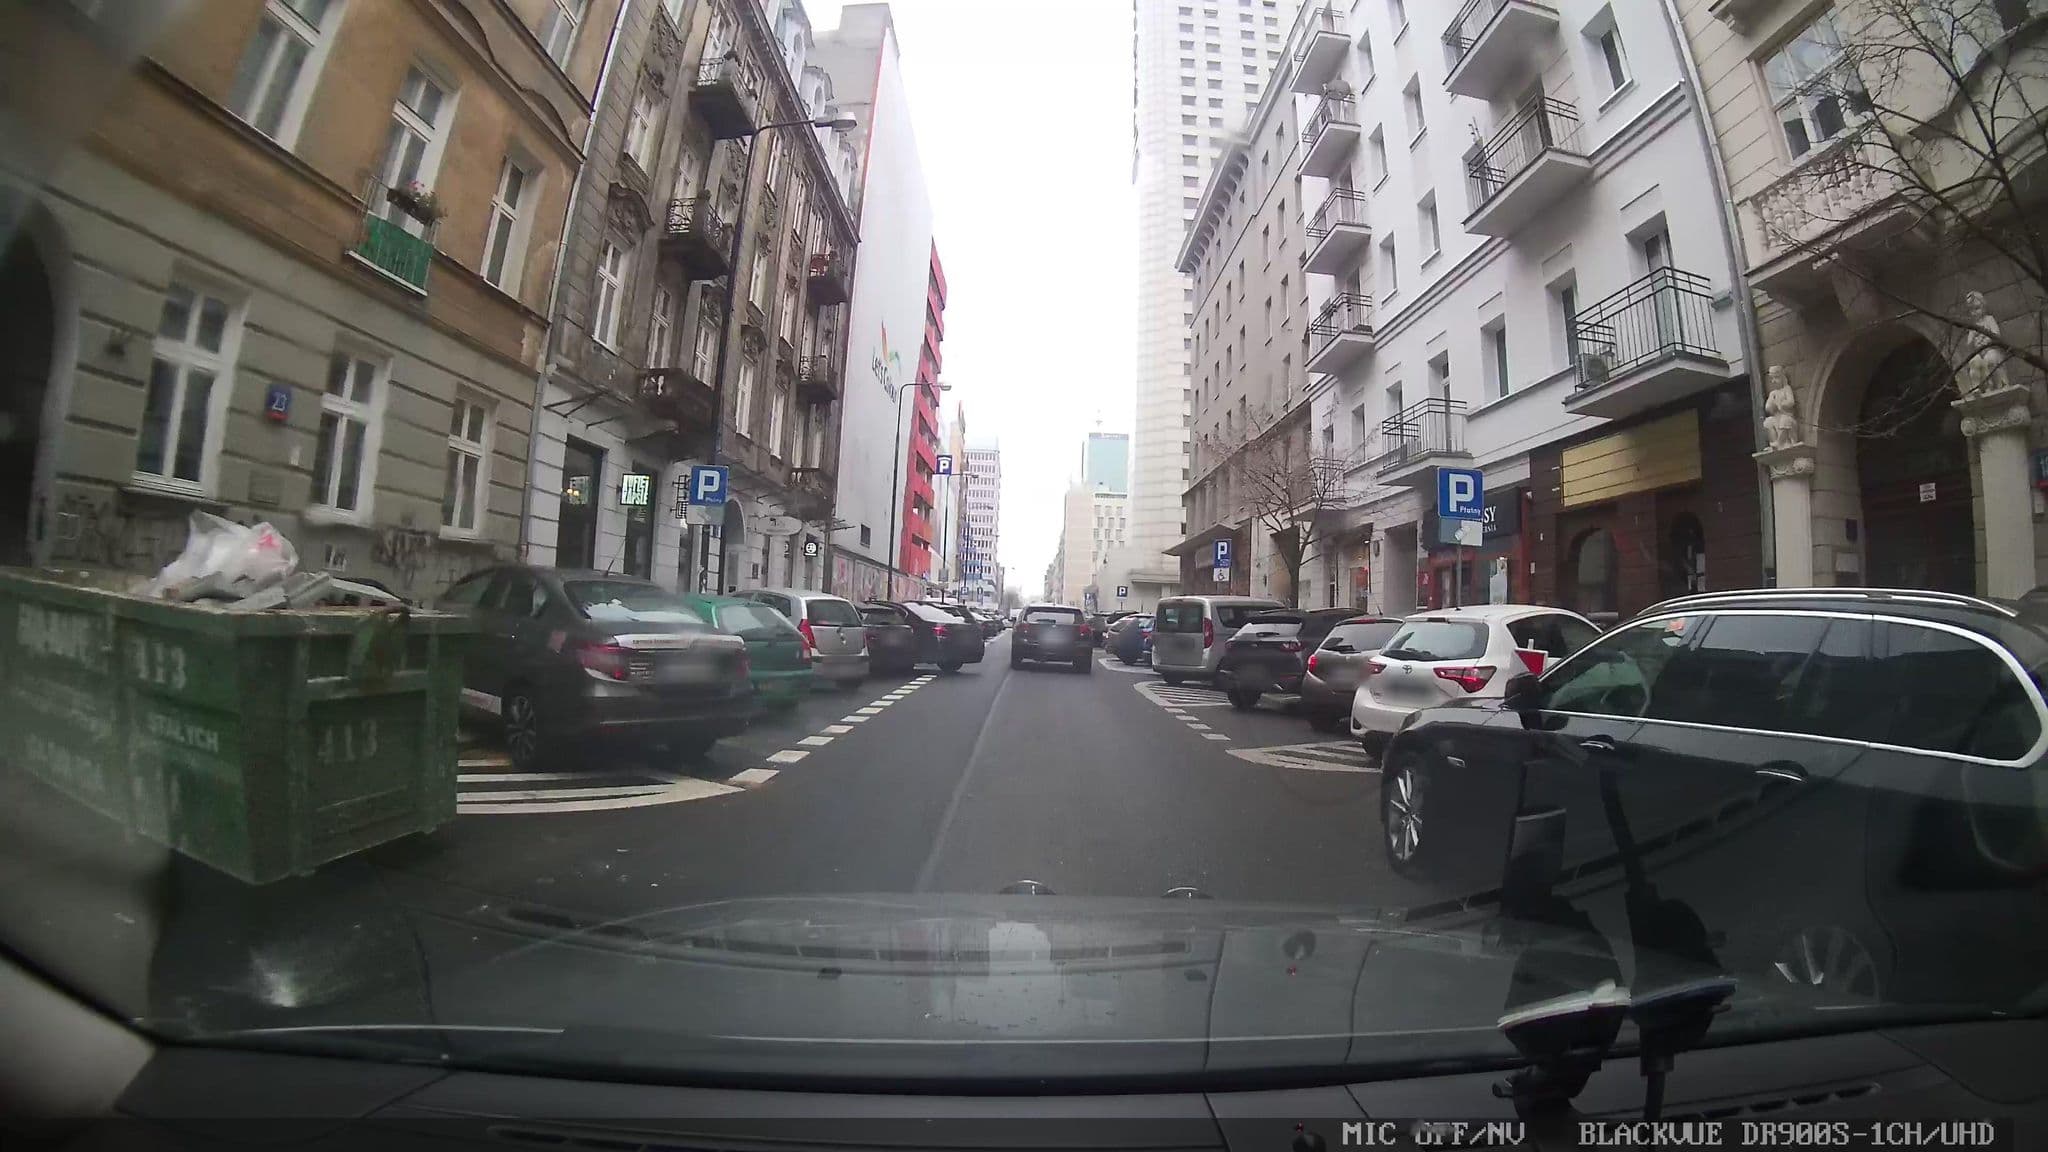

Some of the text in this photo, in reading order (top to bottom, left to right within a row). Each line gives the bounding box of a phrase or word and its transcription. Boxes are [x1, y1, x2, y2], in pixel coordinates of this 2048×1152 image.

[940, 461, 950, 473] P
[697, 470, 720, 500] P
[1449, 473, 1474, 512] P
[1217, 541, 1228, 560] P
